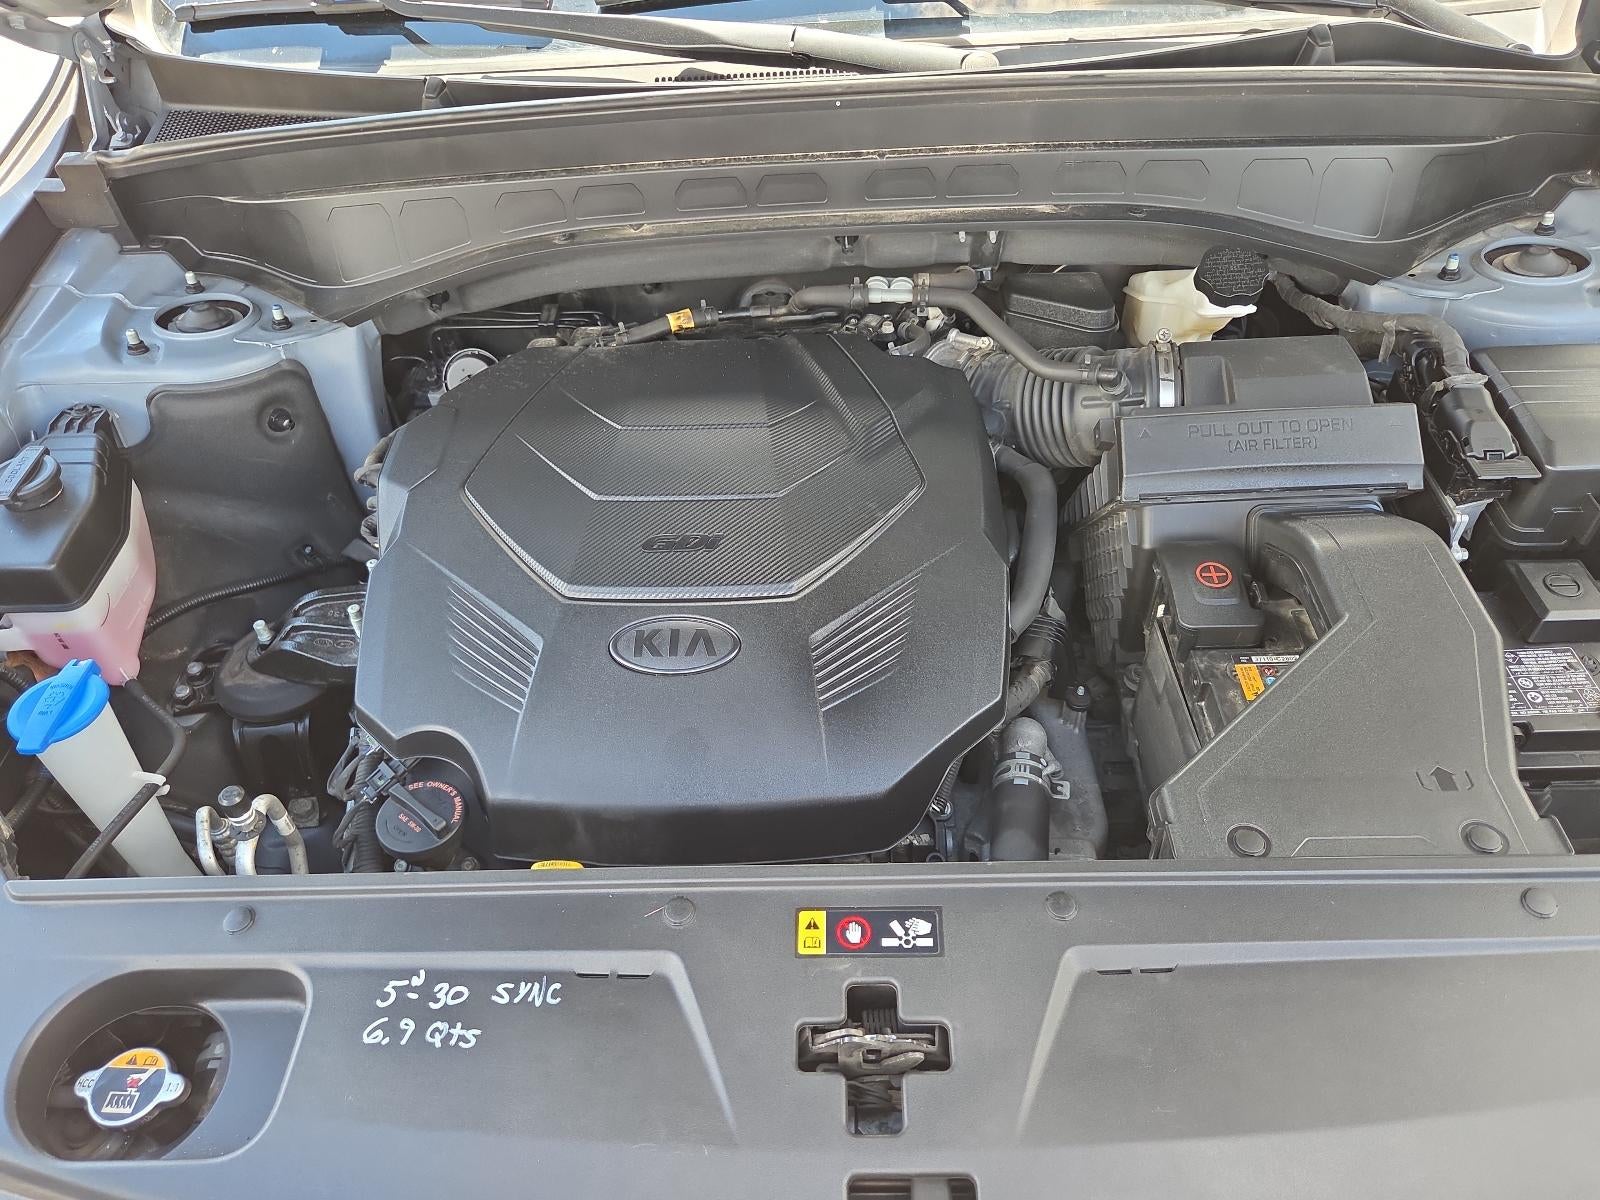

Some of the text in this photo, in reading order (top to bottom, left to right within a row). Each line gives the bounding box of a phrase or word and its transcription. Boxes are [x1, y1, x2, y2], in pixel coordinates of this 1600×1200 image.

[1187, 417, 1353, 439] PULL OUT TO OPEN
[1227, 436, 1318, 453] (AIR FILTER)
[632, 628, 718, 658] KIA
[408, 780, 465, 824] SEE OWNER'S MANUAL
[491, 975, 562, 1008] SYNC
[362, 1016, 416, 1046] 6.9
